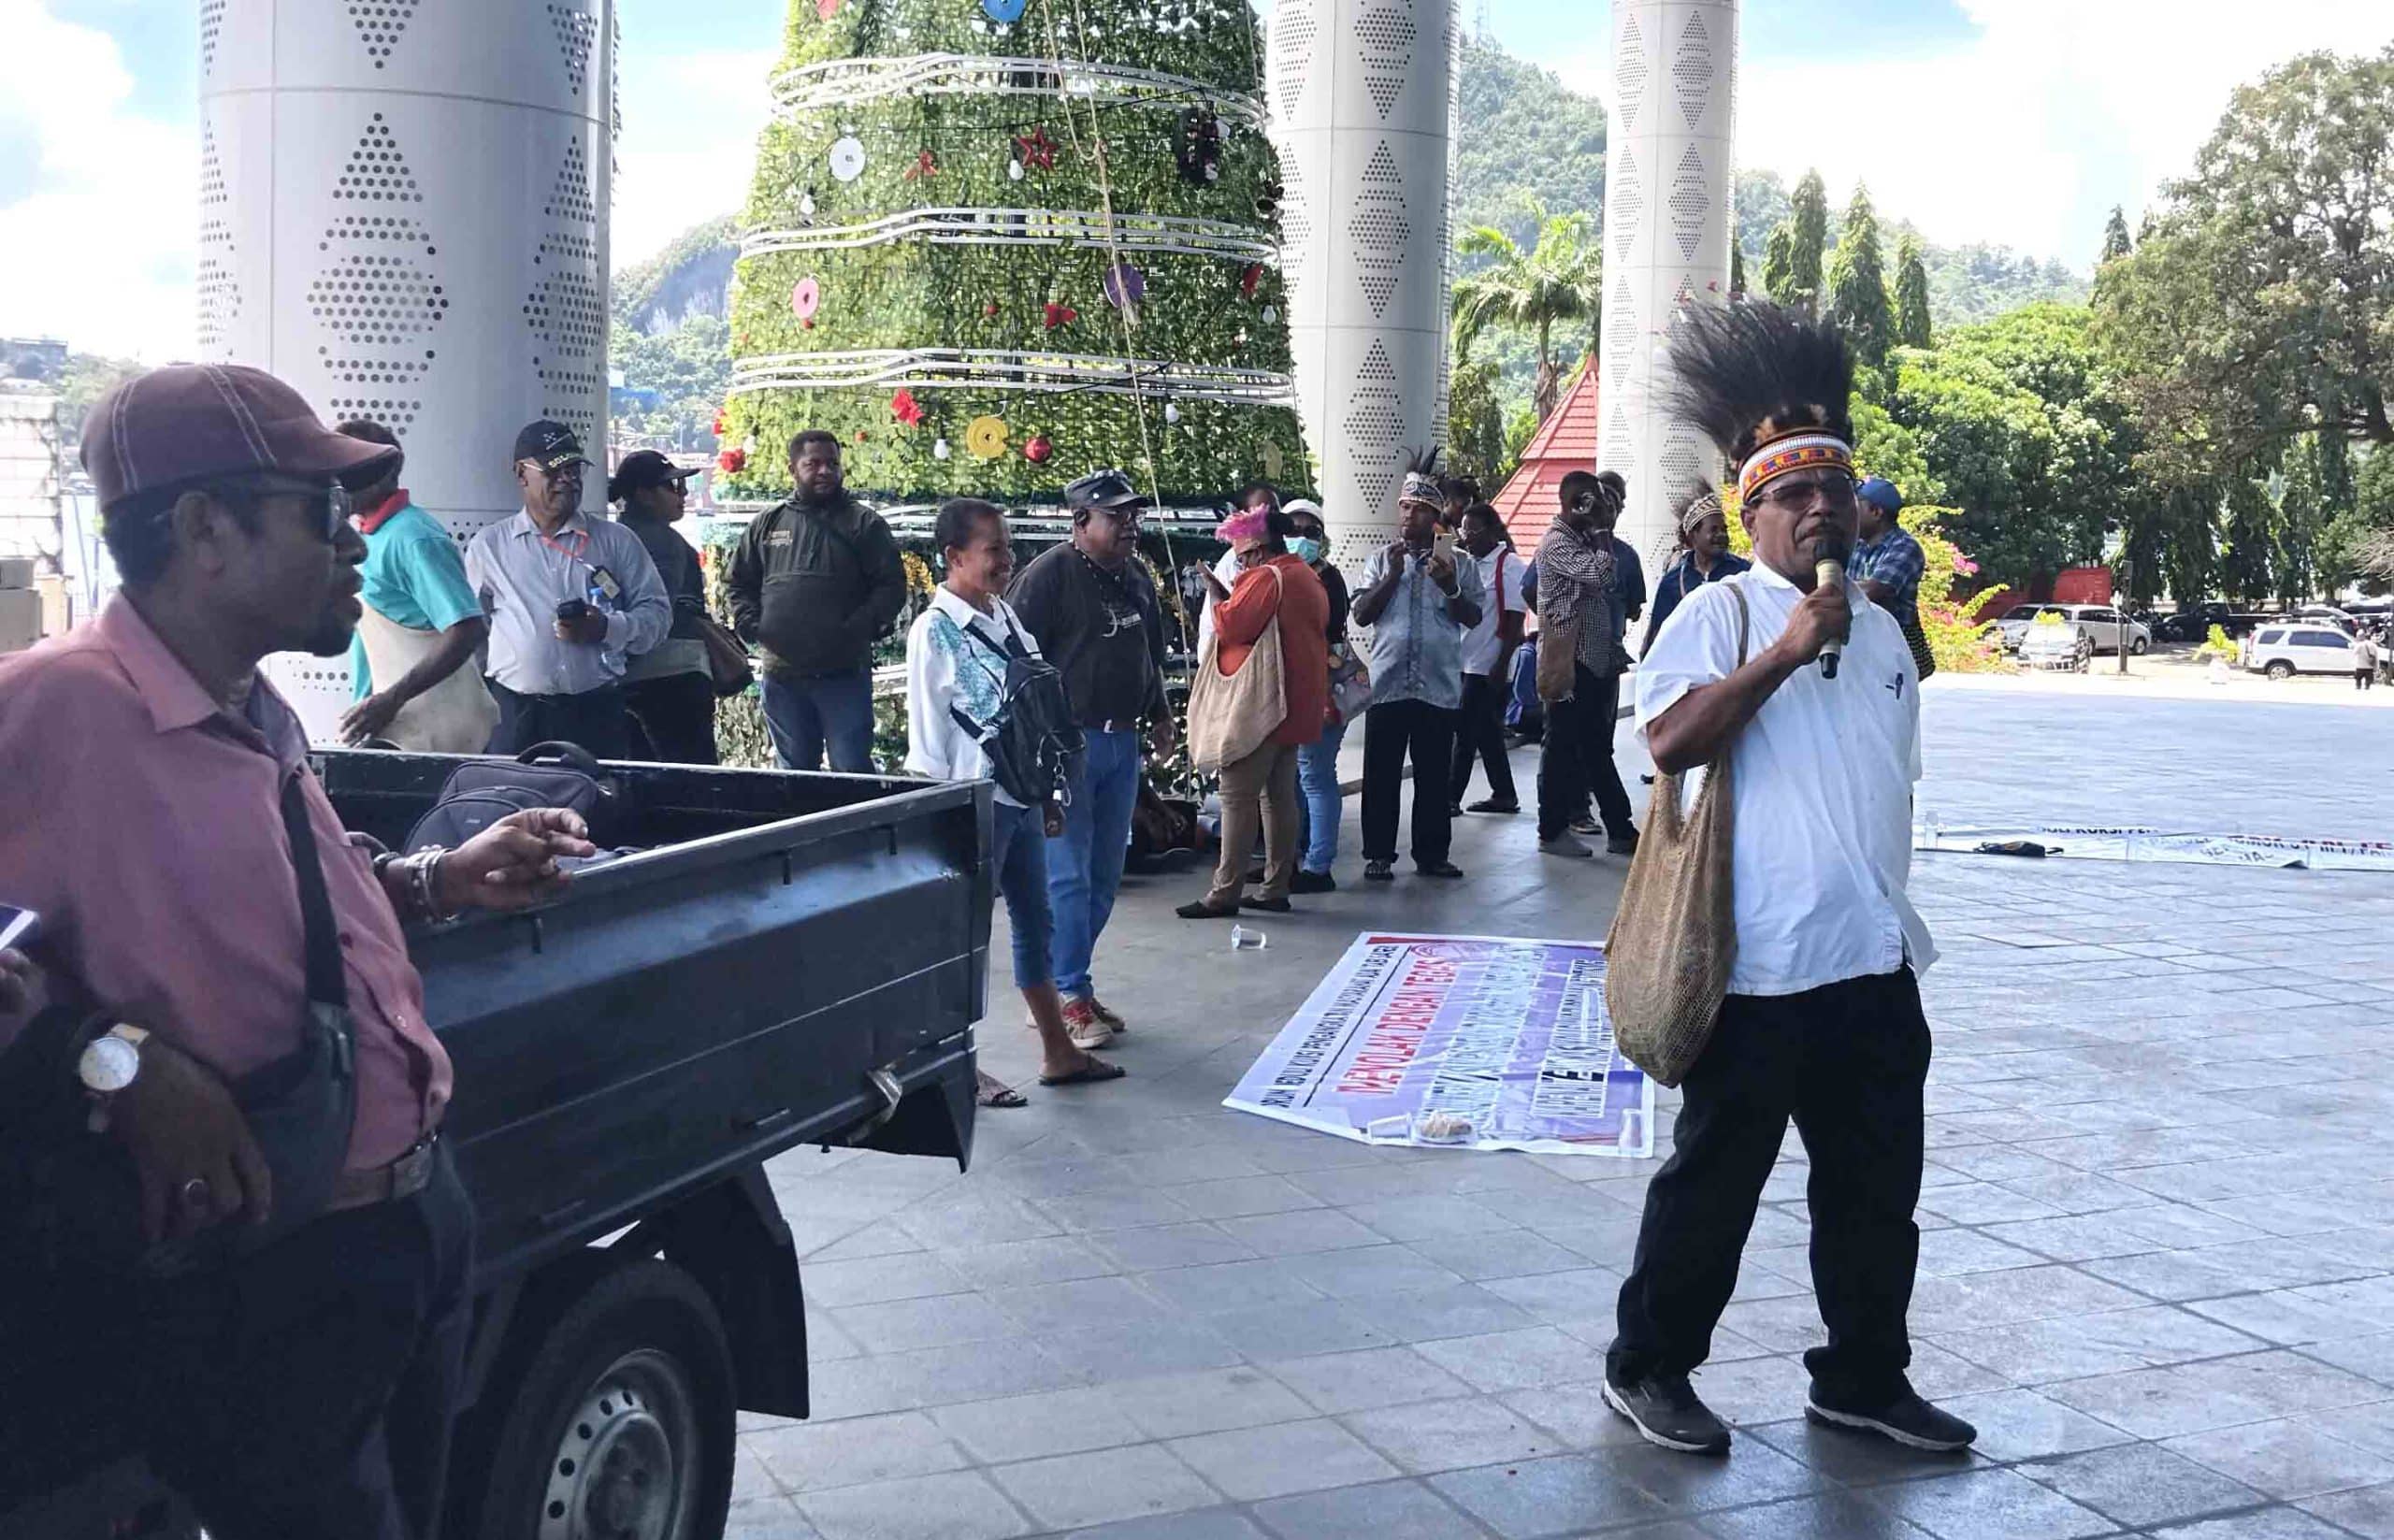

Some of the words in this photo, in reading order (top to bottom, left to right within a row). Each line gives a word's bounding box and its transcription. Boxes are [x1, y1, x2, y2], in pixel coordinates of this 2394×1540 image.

[1402, 959, 1456, 986] TEGAS
[1376, 989, 1448, 1031] DENGAN
[1336, 1033, 1424, 1094] MENOLAK
